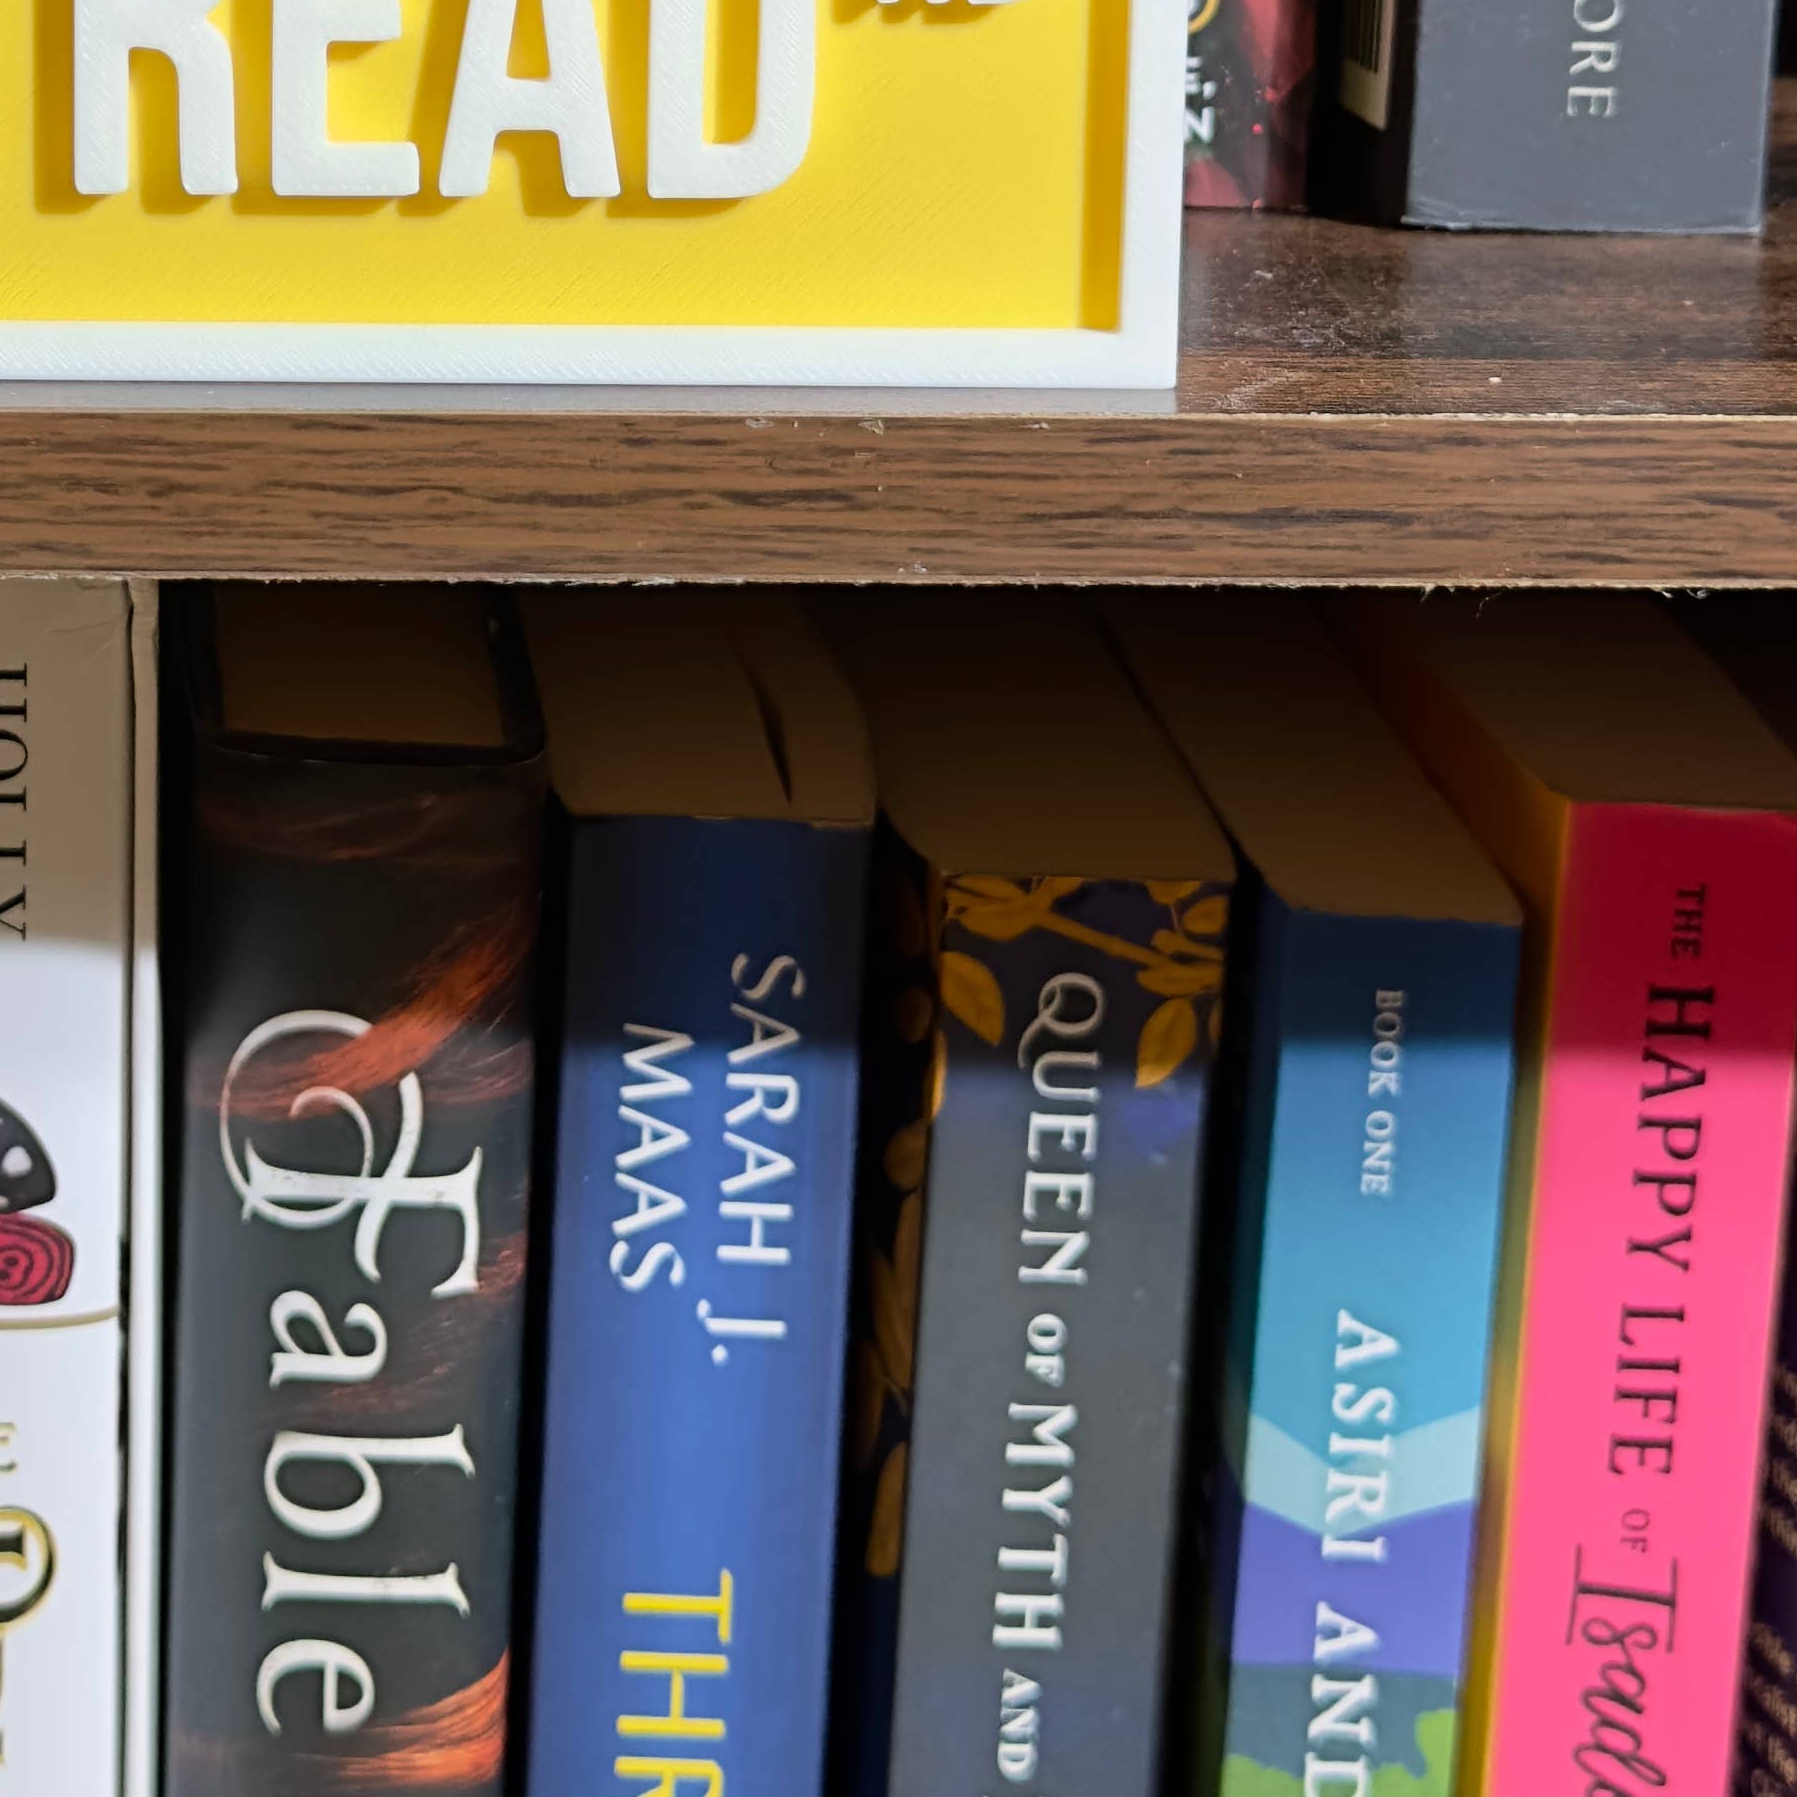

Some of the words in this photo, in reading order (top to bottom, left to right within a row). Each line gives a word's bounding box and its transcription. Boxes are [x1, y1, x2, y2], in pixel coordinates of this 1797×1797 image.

[1670, 882, 1707, 961] THE
[716, 952, 807, 1265] SARAH
[1016, 971, 1106, 1286] QUEEN
[1370, 988, 1406, 1098] BOOK
[1626, 981, 1716, 1274] HAPPY
[608, 1021, 697, 1294] MAAS
[1360, 1110, 1397, 1198] ONE
[220, 1008, 486, 1736] Fable
[697, 1297, 789, 1365] J.
[1024, 1312, 1069, 1389] OF
[1607, 1301, 1686, 1478] LIFE
[1321, 1309, 1399, 1563] ASIRI
[992, 1402, 1079, 1651] MYTH
[1621, 1507, 1651, 1554] OF
[996, 1666, 1044, 1782] AND
